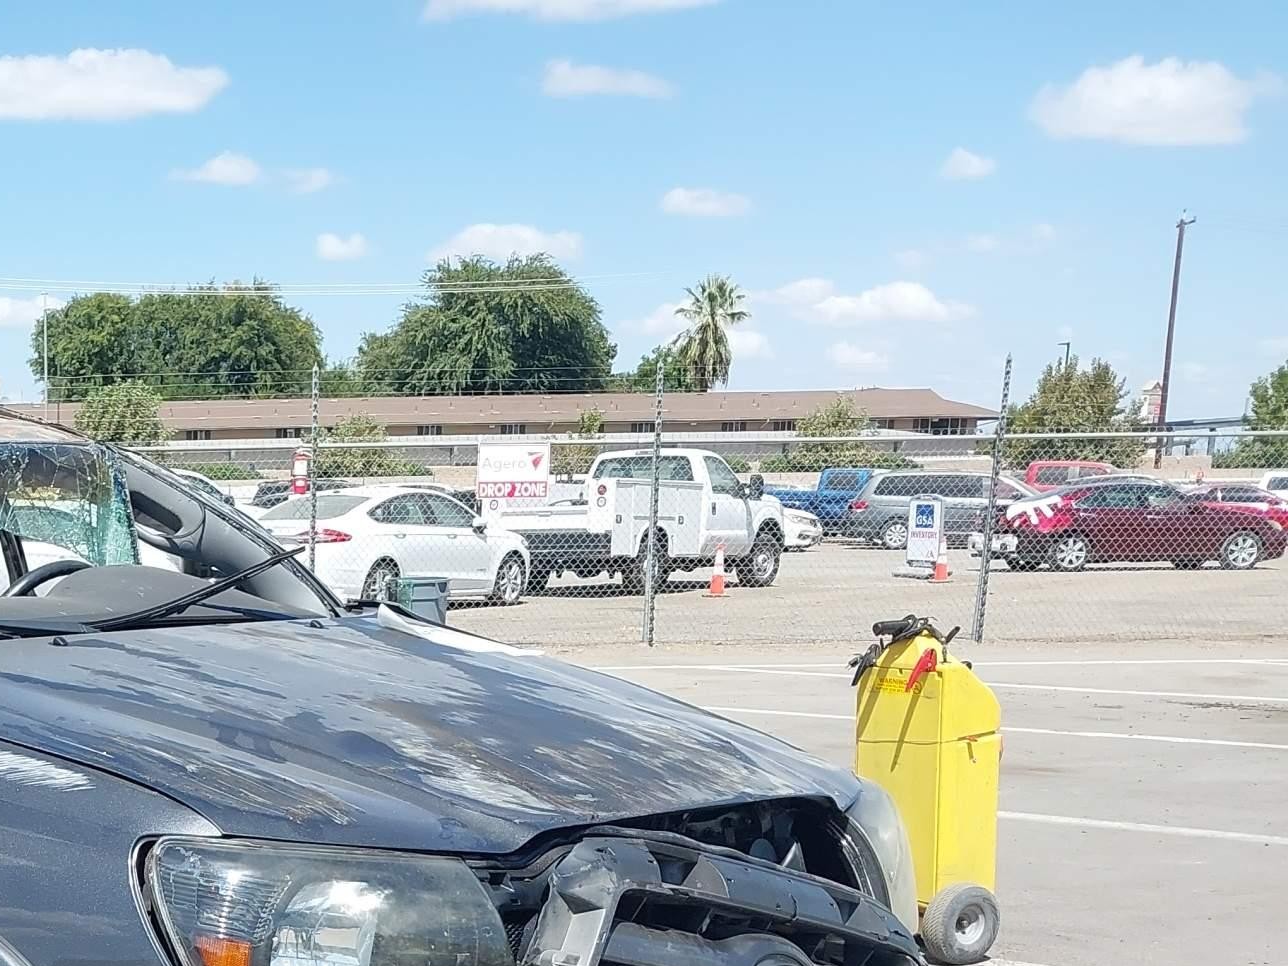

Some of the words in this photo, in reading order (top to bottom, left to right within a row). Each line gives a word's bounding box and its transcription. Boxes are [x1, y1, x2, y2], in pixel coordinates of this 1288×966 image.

[482, 457, 527, 473] Agero
[480, 483, 512, 497] DROP
[514, 483, 546, 497] ZONE
[916, 515, 933, 525] GSA
[910, 531, 937, 539] INVENTORY
